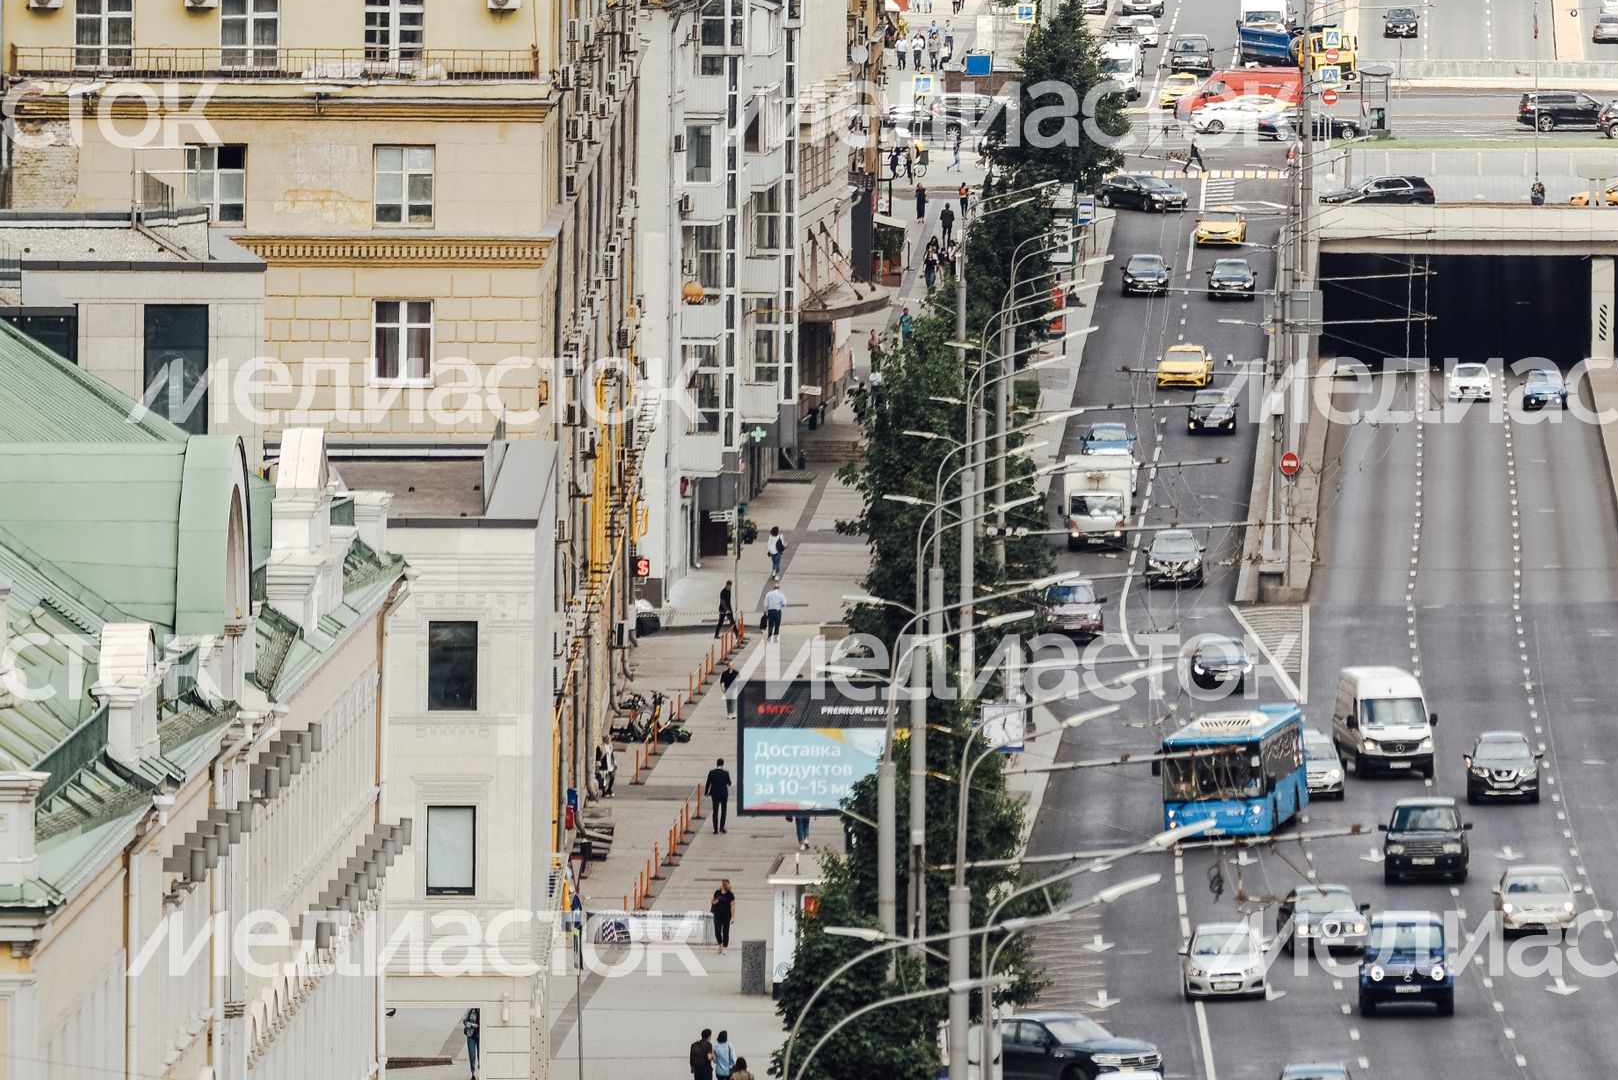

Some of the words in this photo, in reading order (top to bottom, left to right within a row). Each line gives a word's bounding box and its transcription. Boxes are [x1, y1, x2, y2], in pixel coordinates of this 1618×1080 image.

[820, 706, 900, 716] PREMIUM.MTS.U
[754, 741, 841, 760] Доставка
[754, 763, 853, 779] продуктов
[754, 783, 774, 795] за
